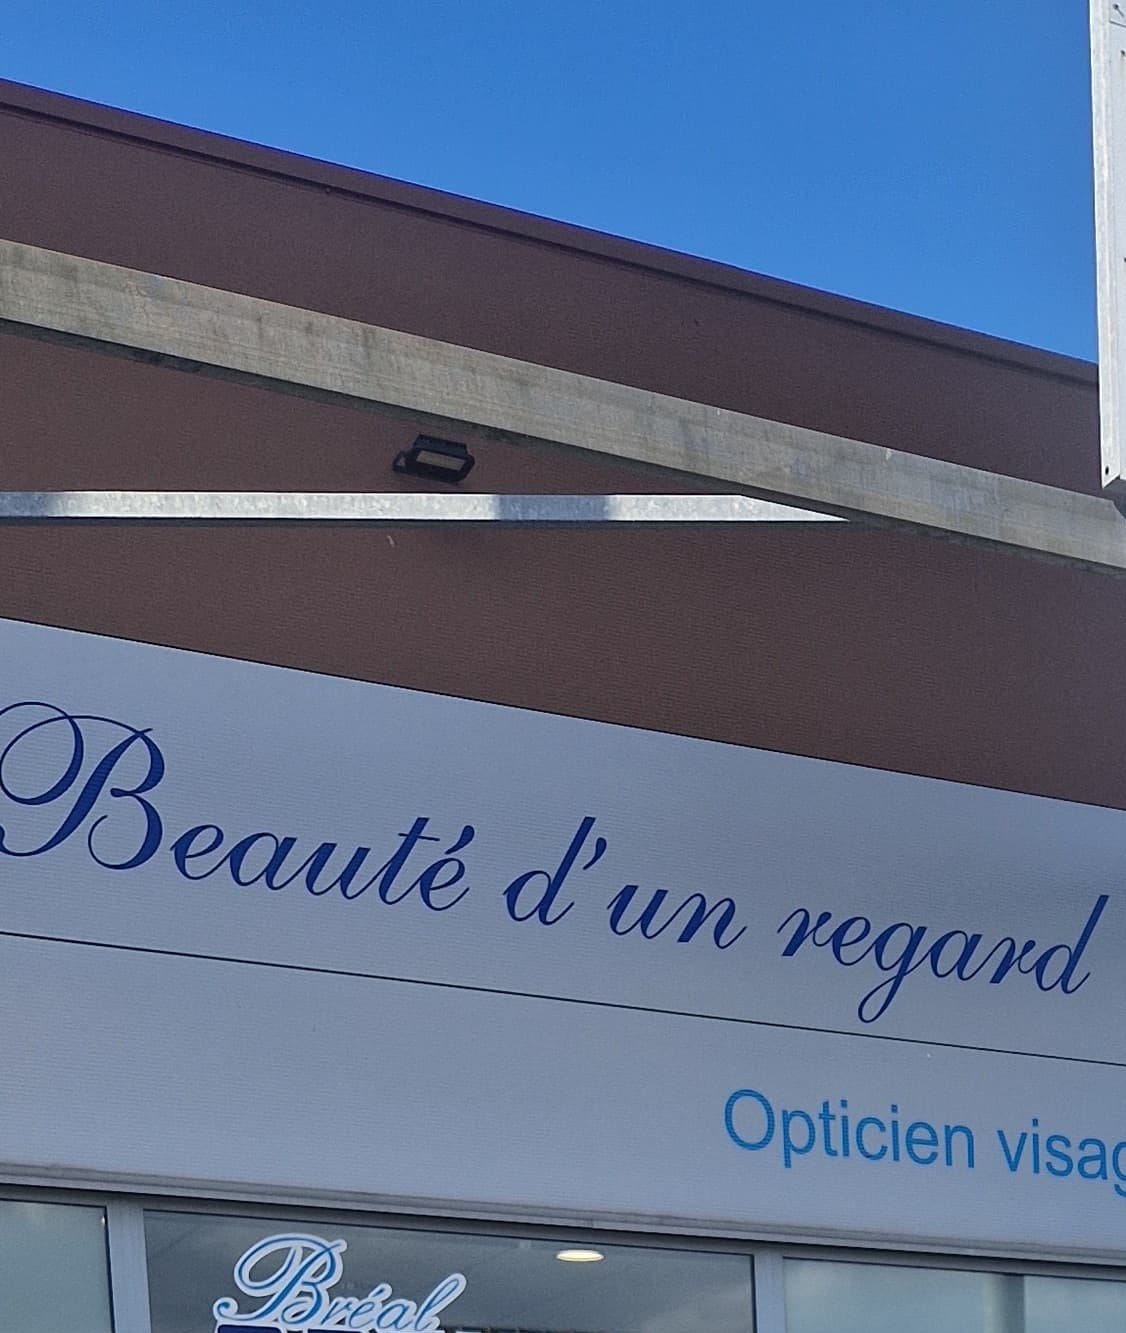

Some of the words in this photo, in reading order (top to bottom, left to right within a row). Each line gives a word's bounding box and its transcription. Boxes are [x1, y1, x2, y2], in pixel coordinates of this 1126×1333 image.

[0, 702, 475, 911] Beauté
[502, 816, 748, 950] d'un
[777, 895, 1109, 1024] regard
[724, 1088, 976, 1169] Opticien
[214, 1234, 467, 1330] Bréal
